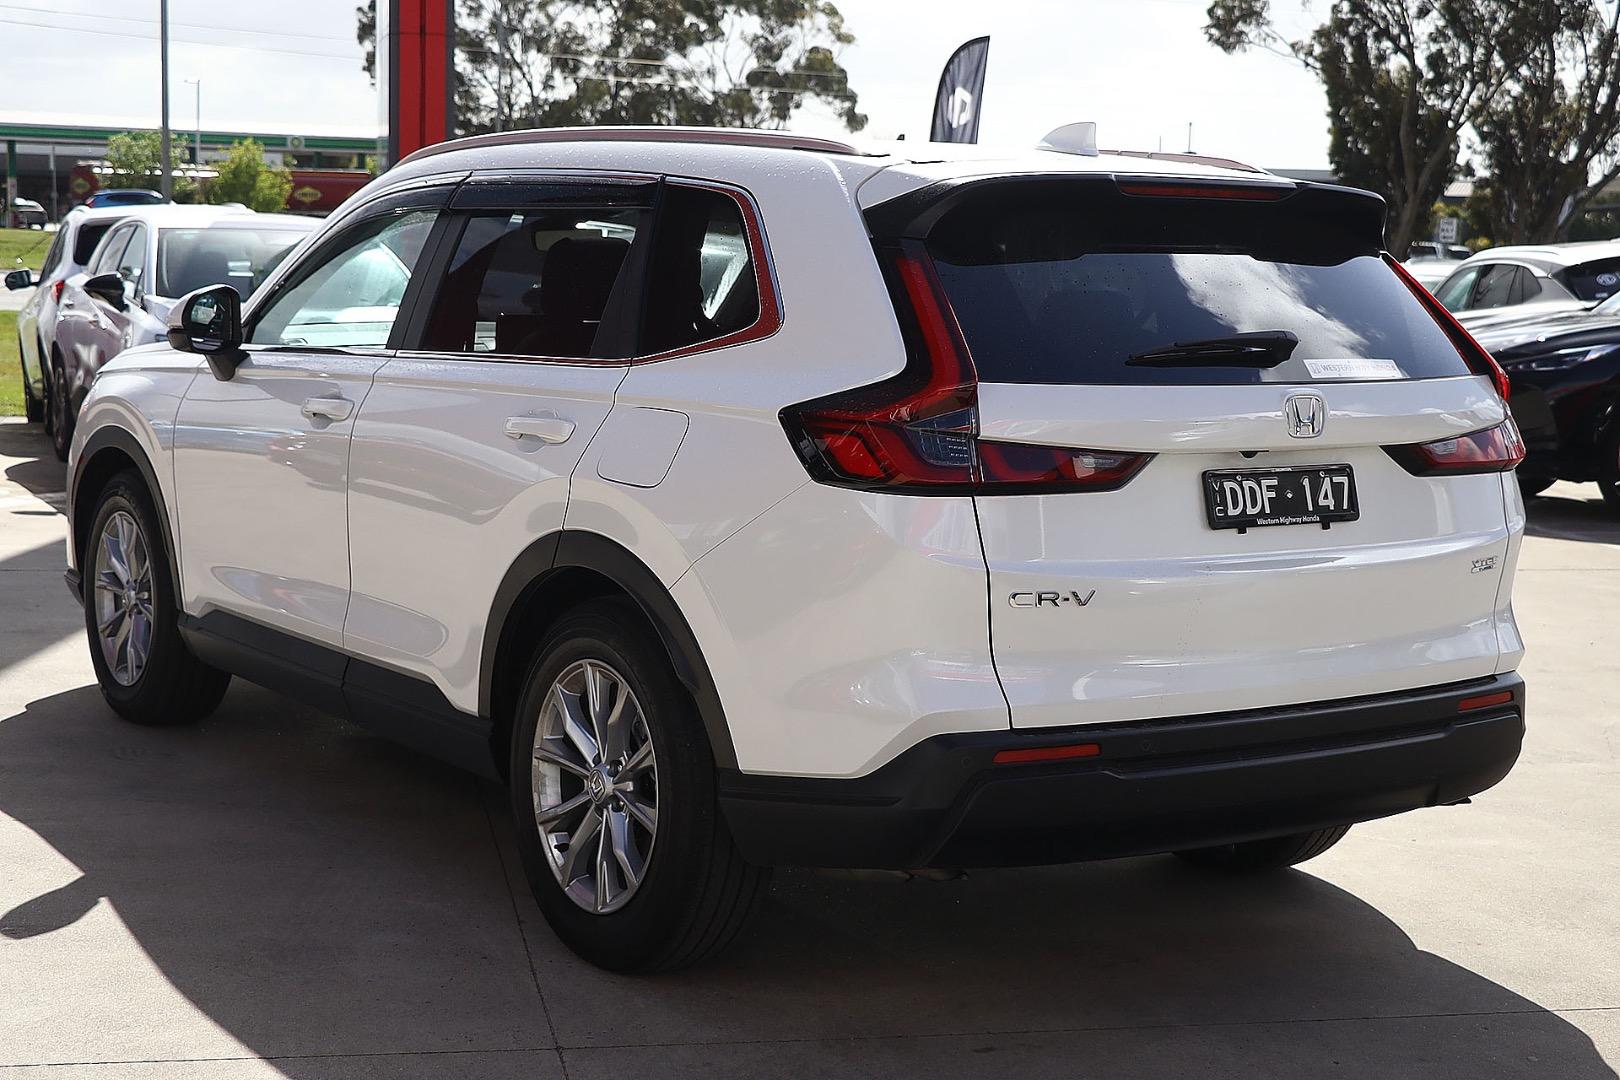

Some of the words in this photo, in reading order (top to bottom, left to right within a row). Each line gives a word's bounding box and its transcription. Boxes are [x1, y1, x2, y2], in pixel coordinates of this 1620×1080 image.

[1223, 479, 1279, 516] DDF
[1302, 476, 1348, 511] 147
[1280, 516, 1302, 525] Highway
[1302, 514, 1320, 522] Honda
[1008, 589, 1096, 608] CR-V
